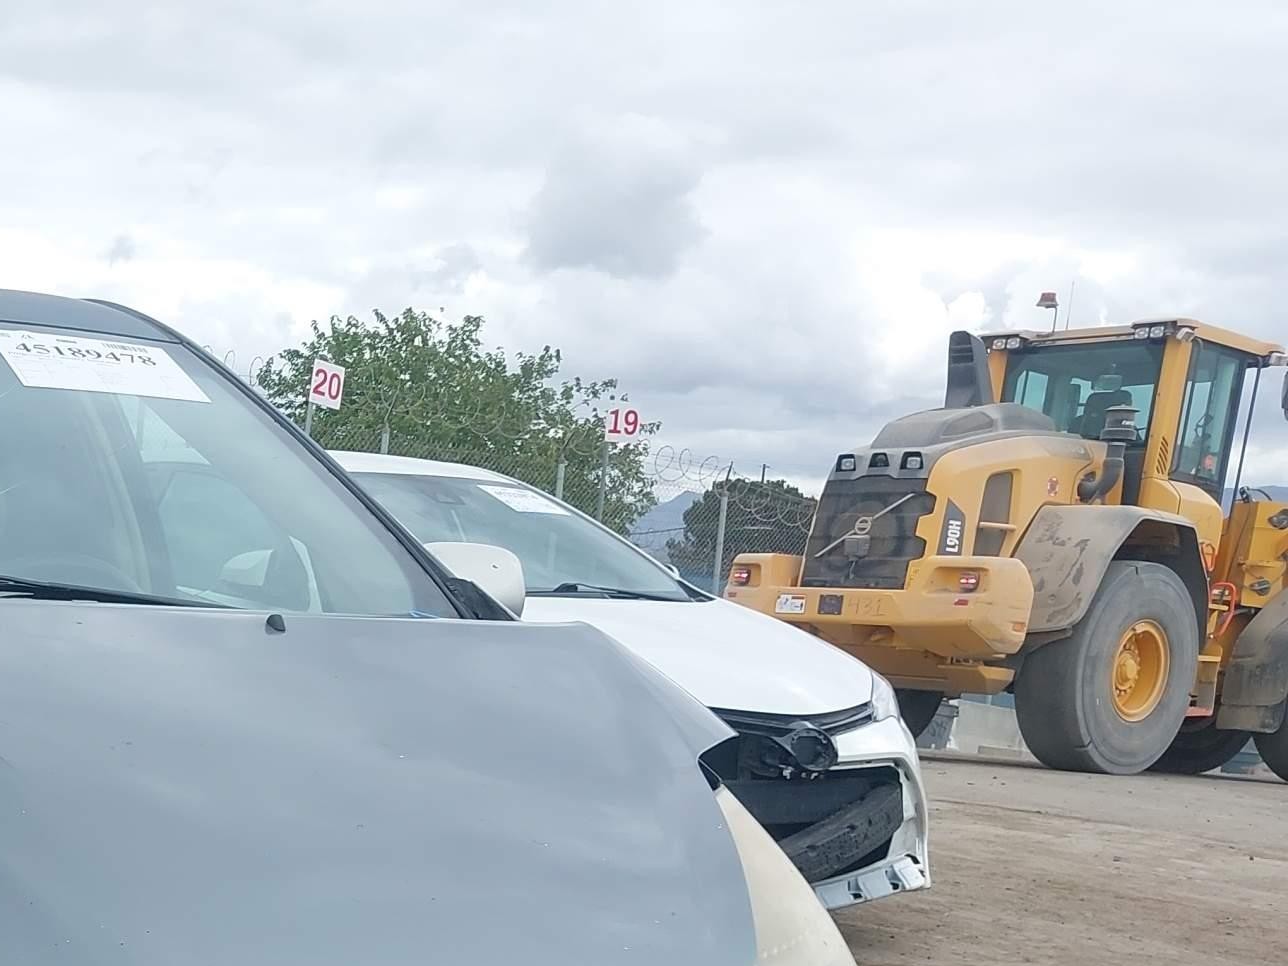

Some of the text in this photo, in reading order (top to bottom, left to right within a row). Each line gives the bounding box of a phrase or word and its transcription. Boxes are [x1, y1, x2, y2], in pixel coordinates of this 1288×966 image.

[15, 342, 157, 366] 45189478
[312, 368, 342, 401] 20
[607, 409, 640, 436] 19
[945, 519, 962, 553] L90H
